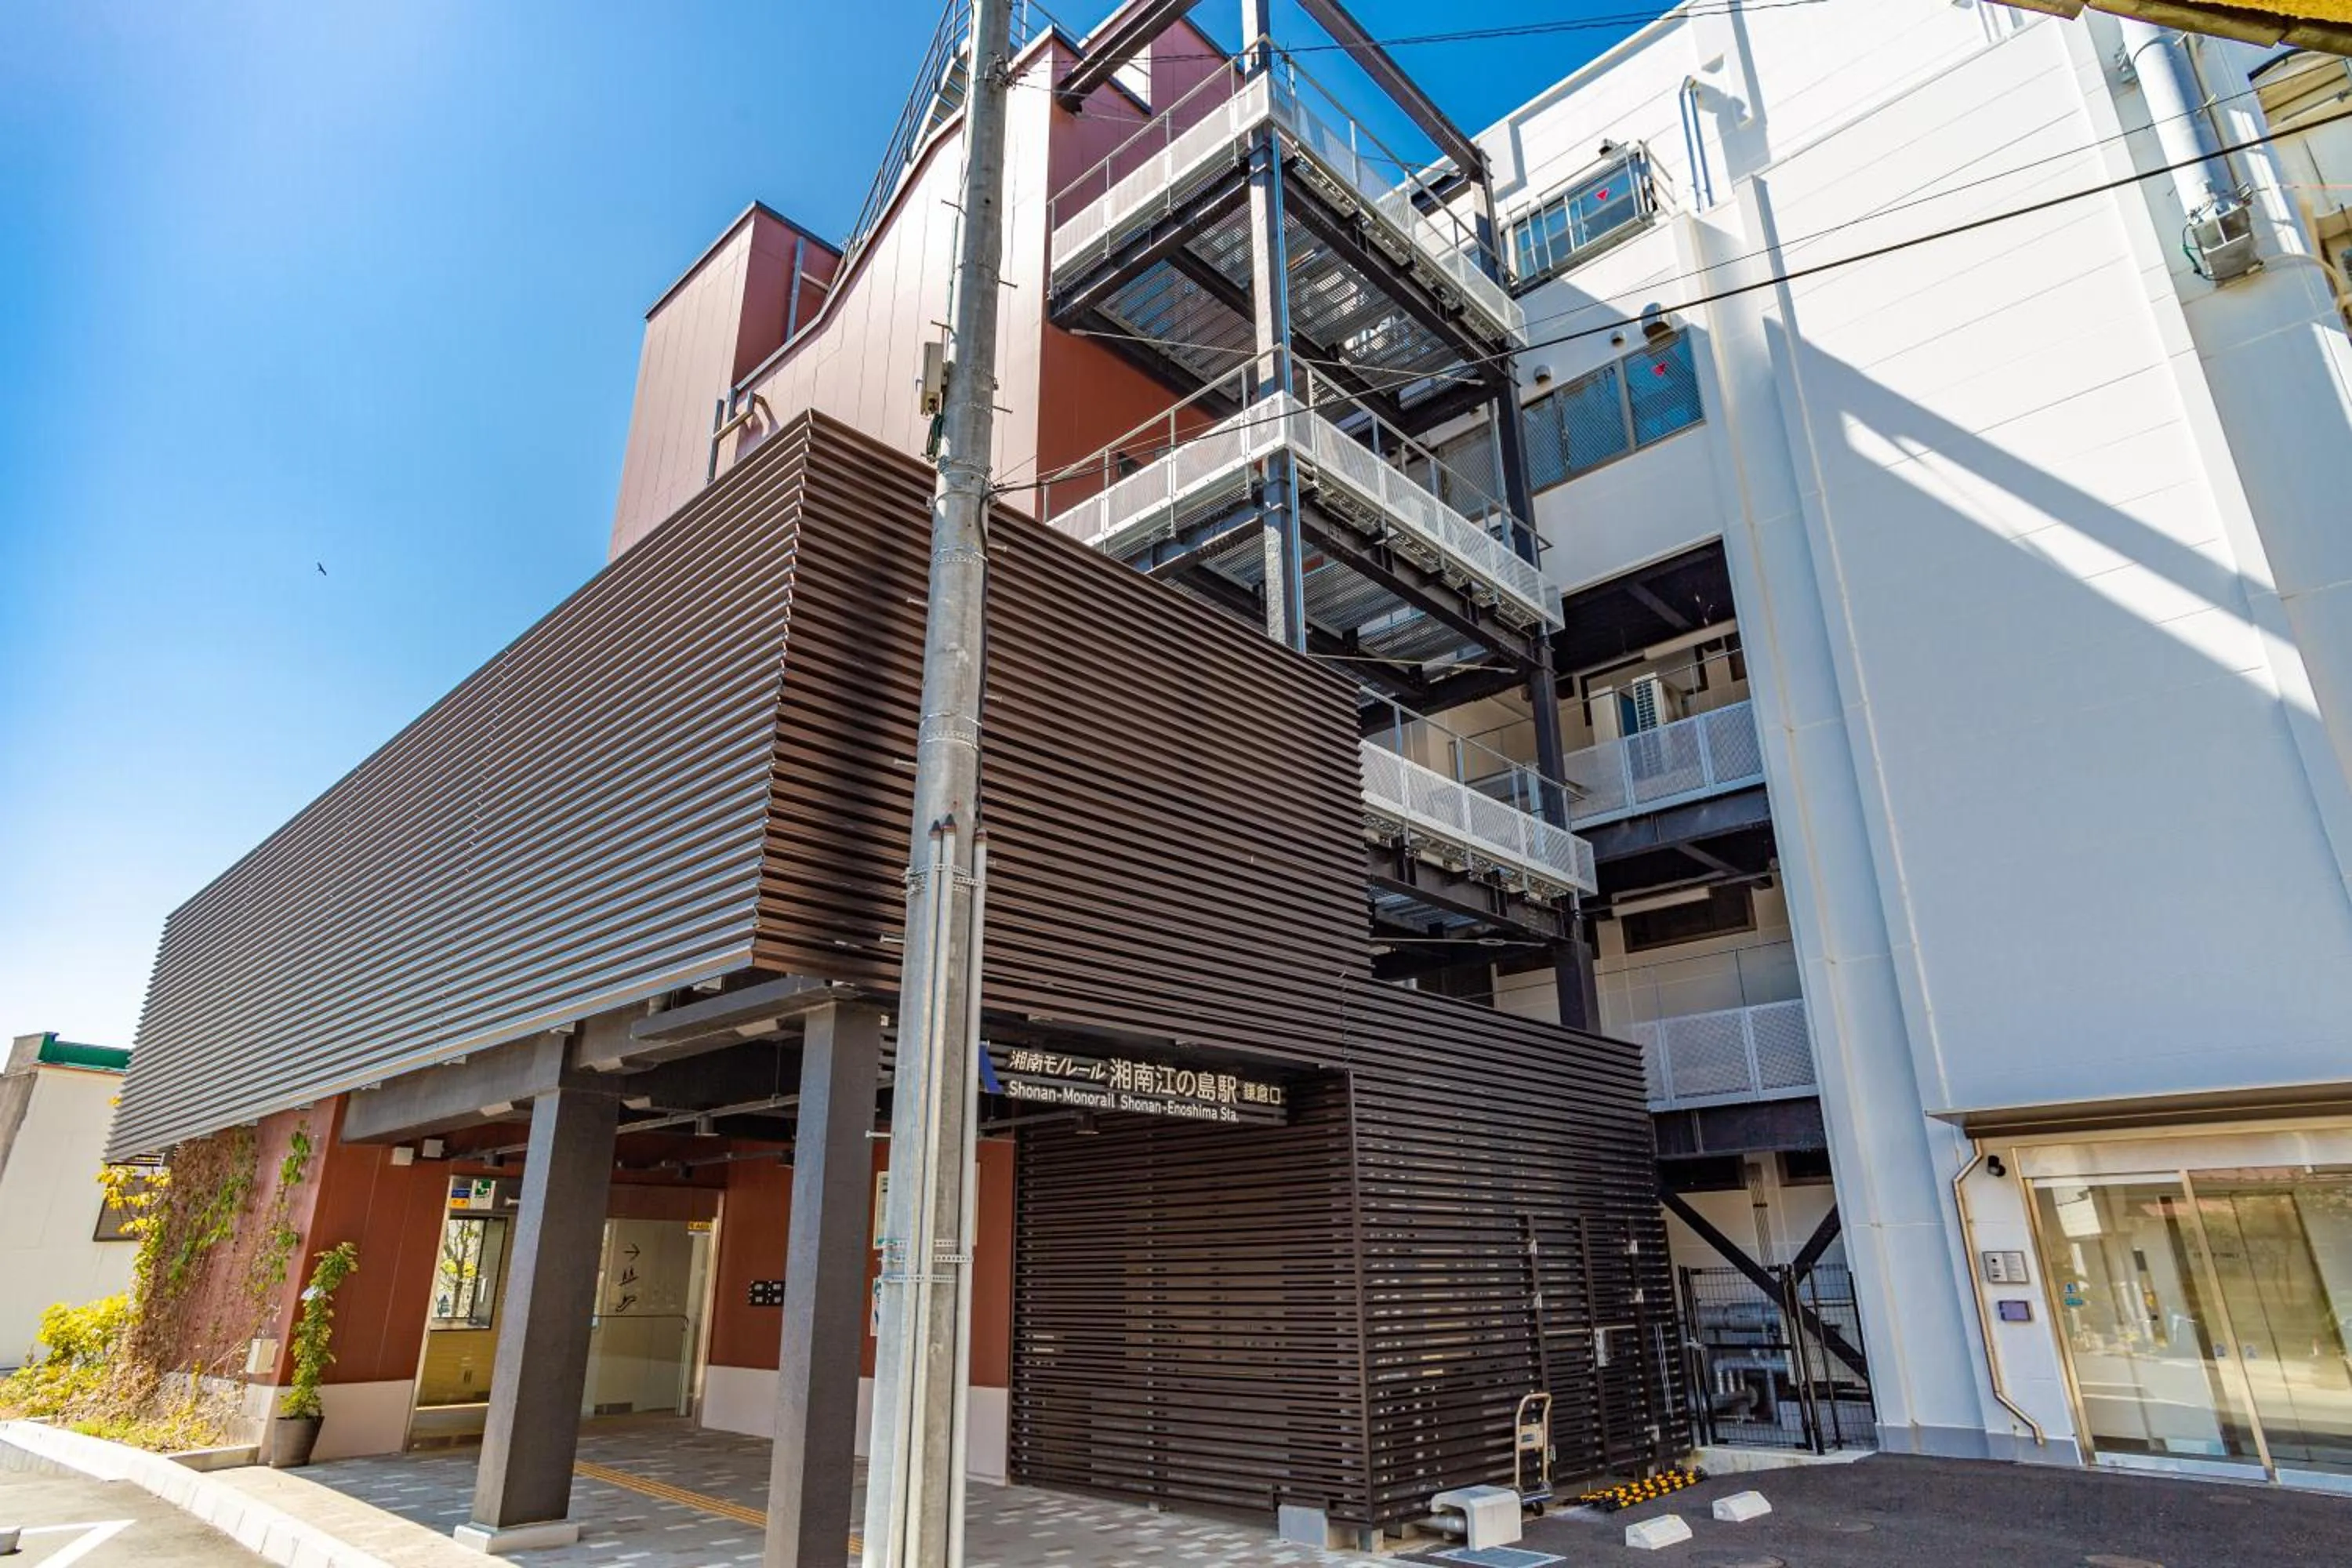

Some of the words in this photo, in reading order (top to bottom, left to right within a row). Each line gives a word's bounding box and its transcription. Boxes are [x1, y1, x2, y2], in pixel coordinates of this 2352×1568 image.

[1009, 1050, 1106, 1080] 湘南モノレール
[1109, 1058, 1237, 1104] 湘南江の島駅
[1009, 1080, 1115, 1108] Shonan-Monorail
[1120, 1094, 1217, 1120] Shonan-Enoshima
[1220, 1107, 1240, 1123] Sta.
